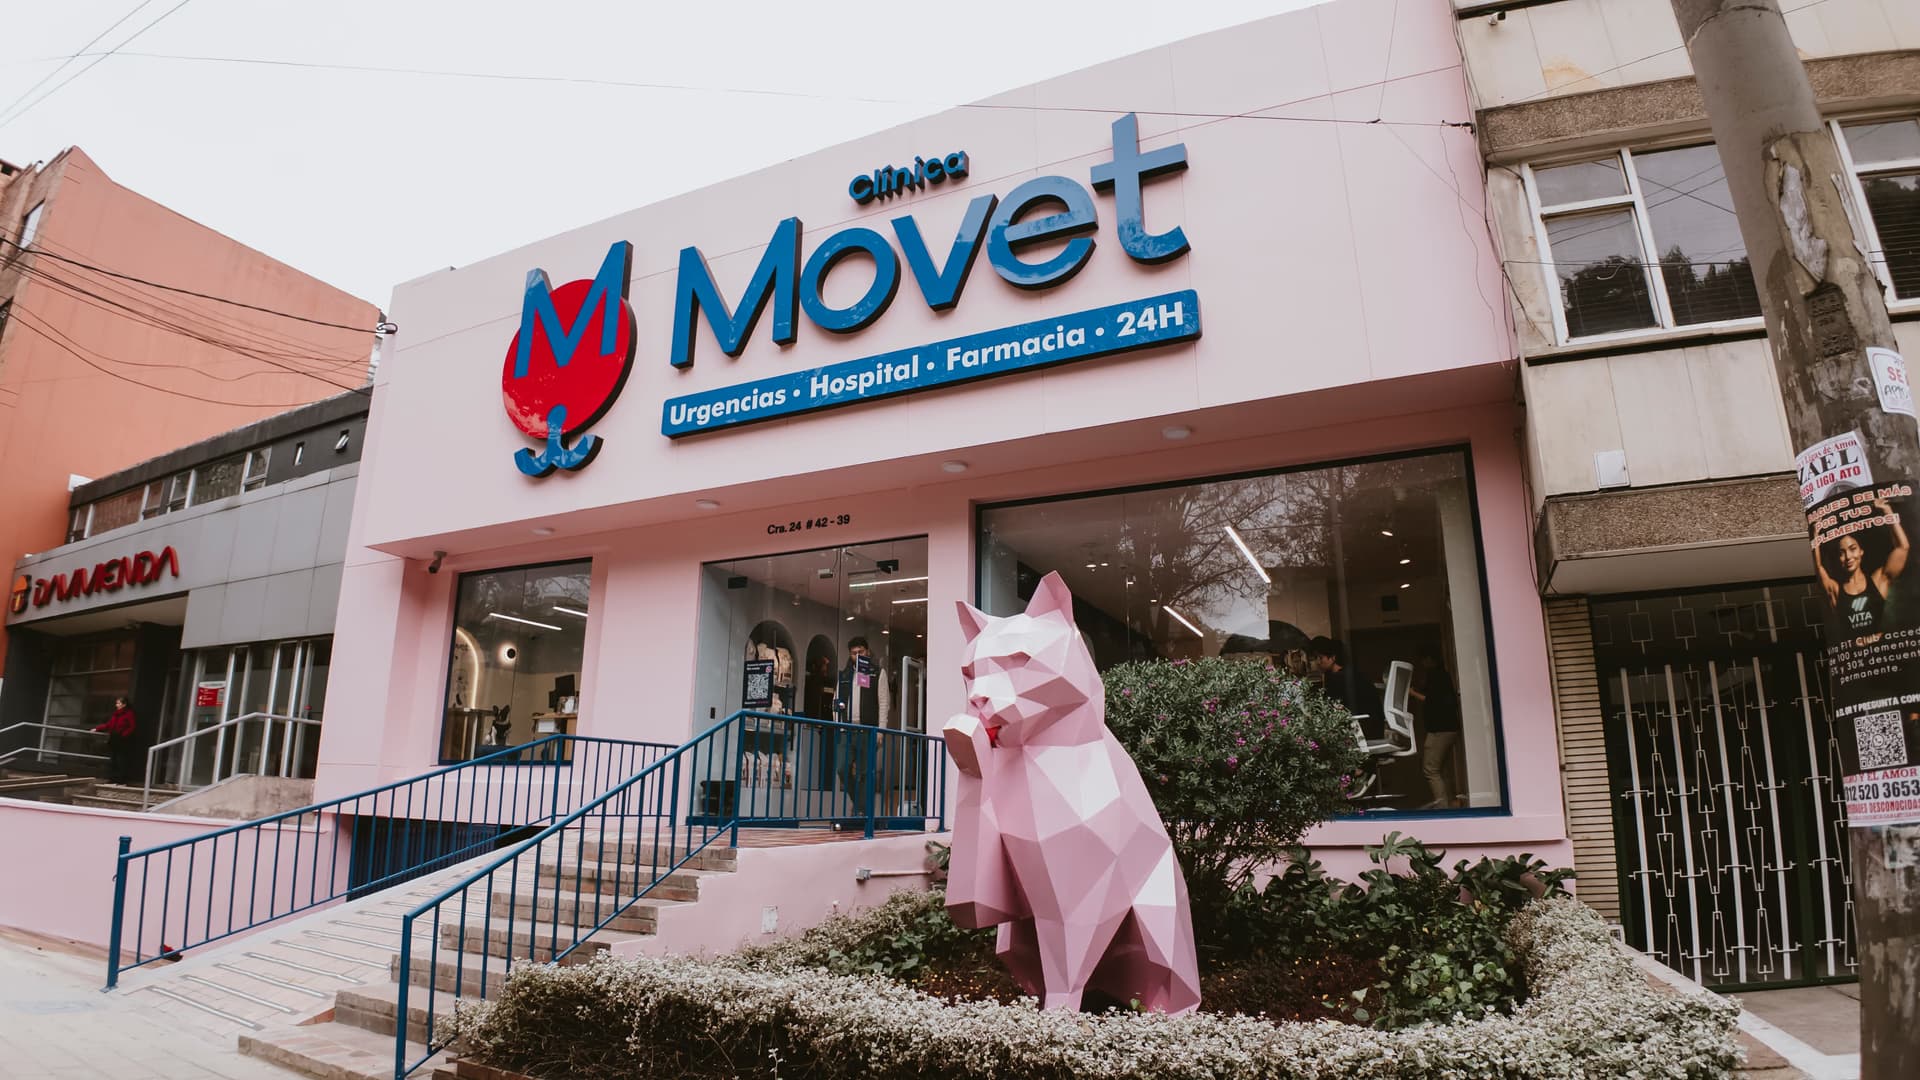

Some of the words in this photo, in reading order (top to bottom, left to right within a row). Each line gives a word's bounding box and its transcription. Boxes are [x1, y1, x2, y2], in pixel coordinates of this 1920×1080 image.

[849, 150, 969, 203] Clínica
[670, 112, 1191, 368] Movet
[669, 388, 787, 427] Urgencias
[810, 354, 919, 400] Hospital
[946, 325, 1085, 371] Farmacia
[1116, 302, 1184, 337] 24H
[1823, 446, 1832, 455] de
[1840, 465, 1861, 480] ATO
[1852, 490, 1875, 504] DE
[1878, 483, 1912, 499] MÁS
[789, 521, 802, 532] 24
[815, 517, 828, 528] 42
[837, 514, 850, 525] 39
[1815, 514, 1838, 533] POR
[1840, 505, 1872, 520] TUS
[1848, 611, 1873, 624] VITA
[1840, 640, 1852, 651] FIT
[1856, 632, 1881, 648] Club
[1837, 651, 1851, 662] 100
[1846, 658, 1865, 672] 30%
[1867, 771, 1879, 782] EL
[1881, 767, 1918, 780] AMOR
[1858, 783, 1880, 801] 520
[1882, 779, 1920, 799] 3653
